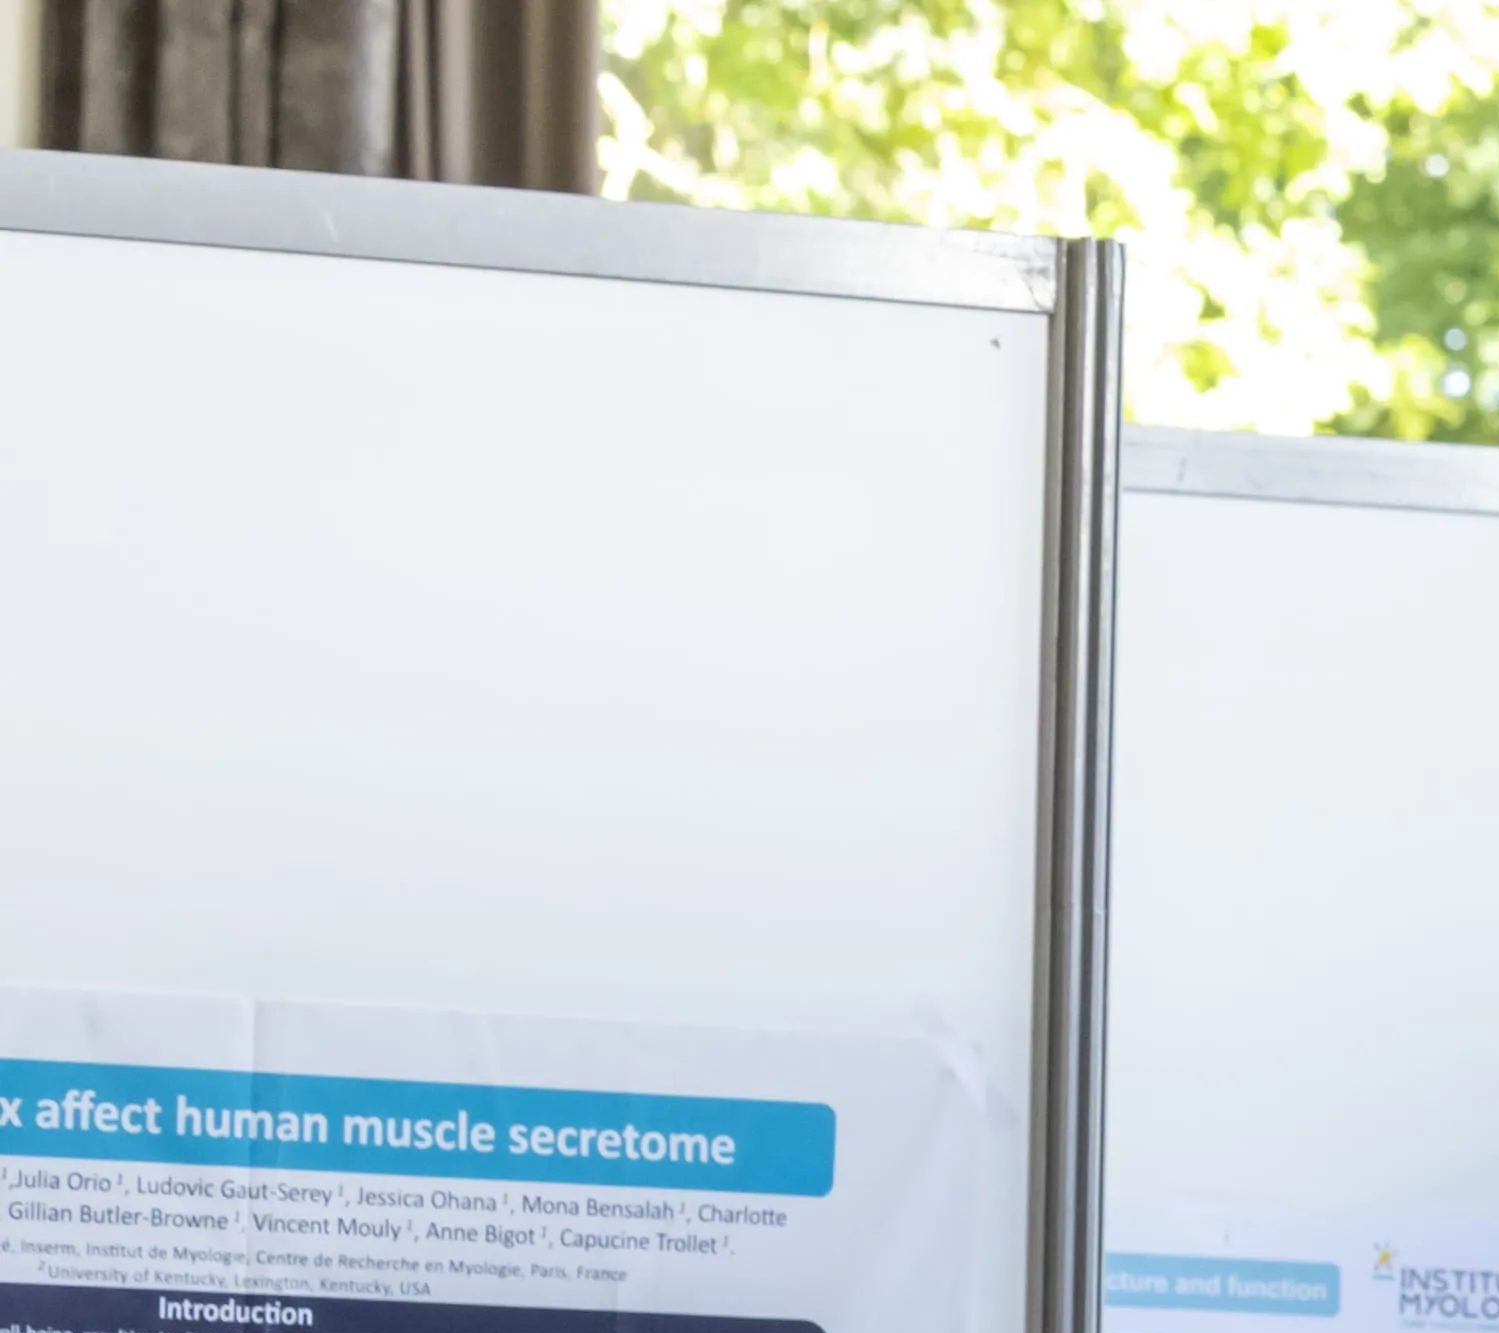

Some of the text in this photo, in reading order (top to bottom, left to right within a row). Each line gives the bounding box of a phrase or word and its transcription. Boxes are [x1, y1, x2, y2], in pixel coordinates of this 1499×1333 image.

[34, 1089, 163, 1135] affect
[176, 1095, 328, 1143] human
[343, 1109, 496, 1153] muscle
[508, 1124, 736, 1165] secretome
[66, 1171, 112, 1192] Orio
[136, 1175, 215, 1199] Ludovic
[219, 1179, 333, 1208] Gaut-Serey
[356, 1187, 425, 1208] Jessica
[430, 1190, 498, 1213] Ohana
[521, 1194, 580, 1217] Mona
[586, 1197, 675, 1220] Bensalah
[697, 1203, 788, 1227] Charlotte
[7, 1200, 717, 1255] Gillian Butler-Browne Vincent Mouly Anne Bigot Capucine Trollet
[158, 1296, 313, 1326] Introduction
[1227, 1274, 1328, 1301] function
